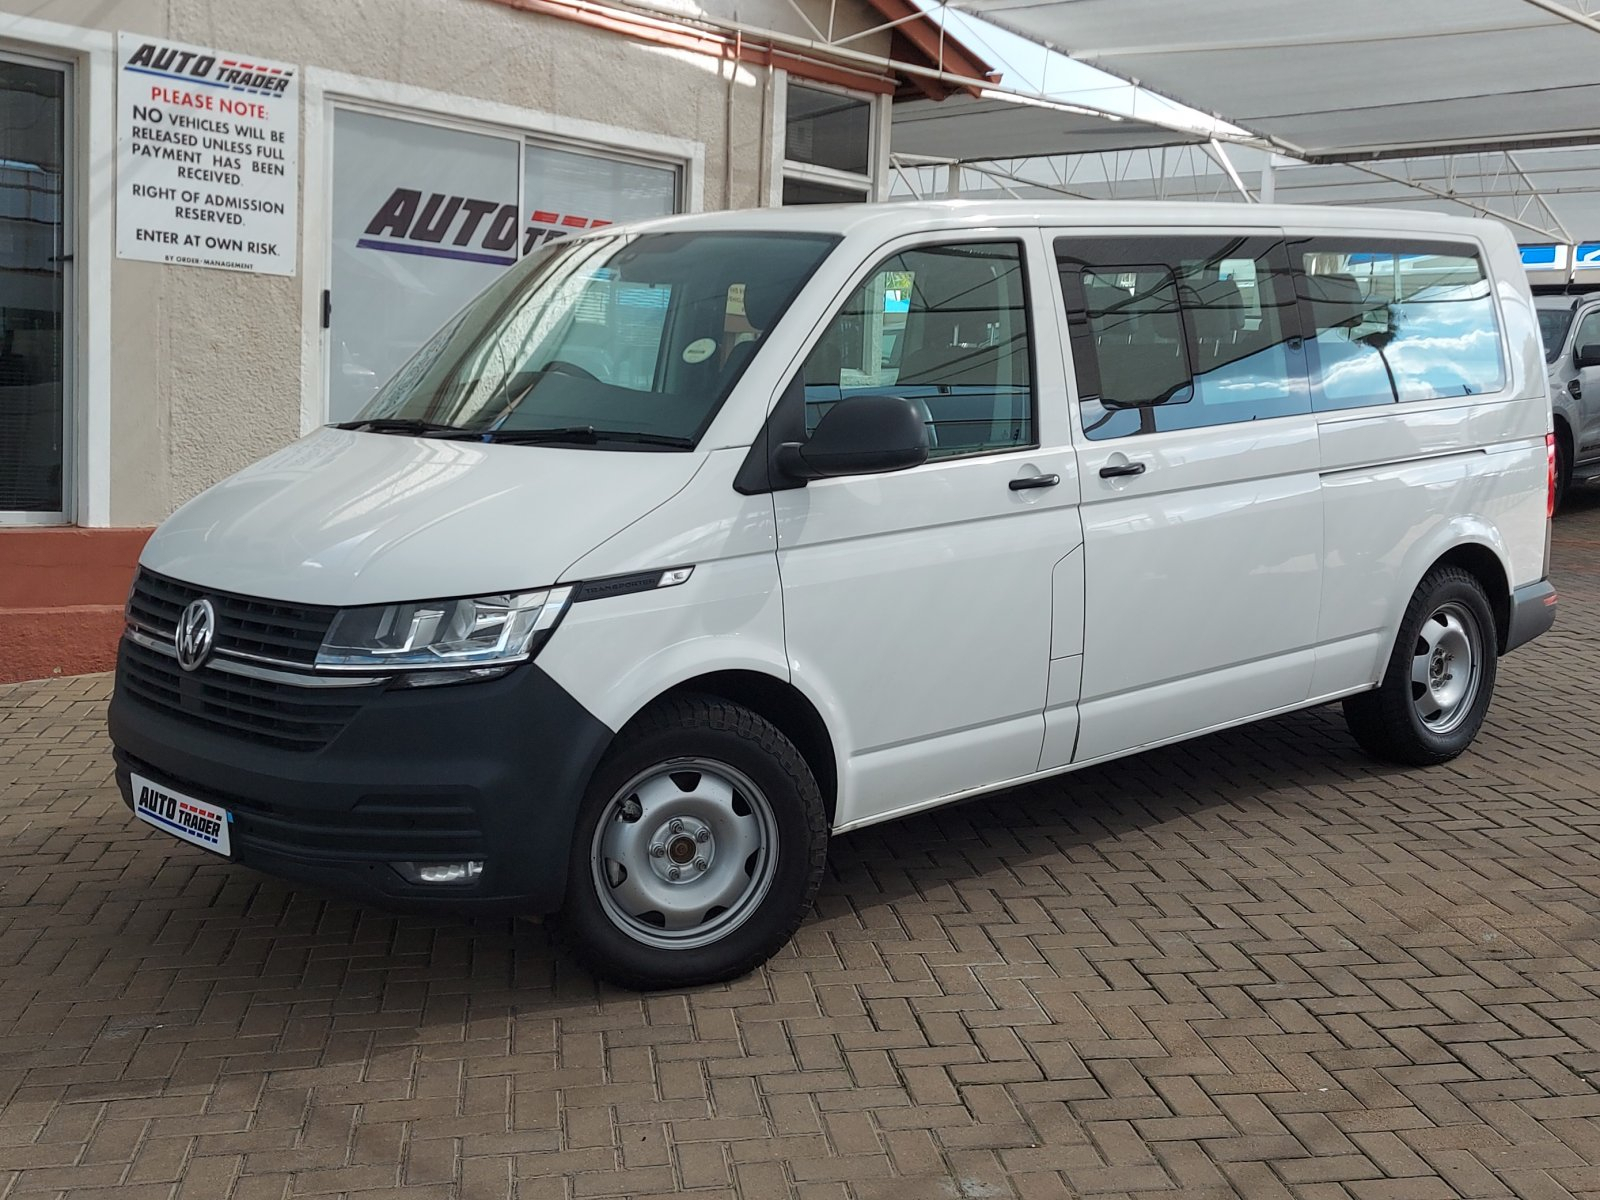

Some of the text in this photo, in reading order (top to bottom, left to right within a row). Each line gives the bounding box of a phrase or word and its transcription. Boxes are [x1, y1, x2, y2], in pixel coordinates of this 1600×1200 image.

[127, 43, 289, 92] AUTO TRADER
[151, 86, 269, 120] PLEASE NOTE:
[132, 104, 285, 143] NO VEHICLES WILL BE
[132, 126, 285, 160] RELEASED UNLESS FULL
[132, 143, 285, 176] PAYMENT HAS BEEN
[177, 166, 244, 187] RECEIVED.
[132, 184, 285, 215] RIGHT OF ADMISSION
[175, 206, 246, 227] RESERVED.
[364, 187, 518, 251] AUTO
[136, 228, 281, 256] ENTER AT OWN RISK.
[176, 256, 199, 264] ORDER
[203, 259, 254, 270] MANAGEMENT
[585, 578, 657, 594] TRANSPORTER
[138, 785, 221, 837] AUTO TRADER
